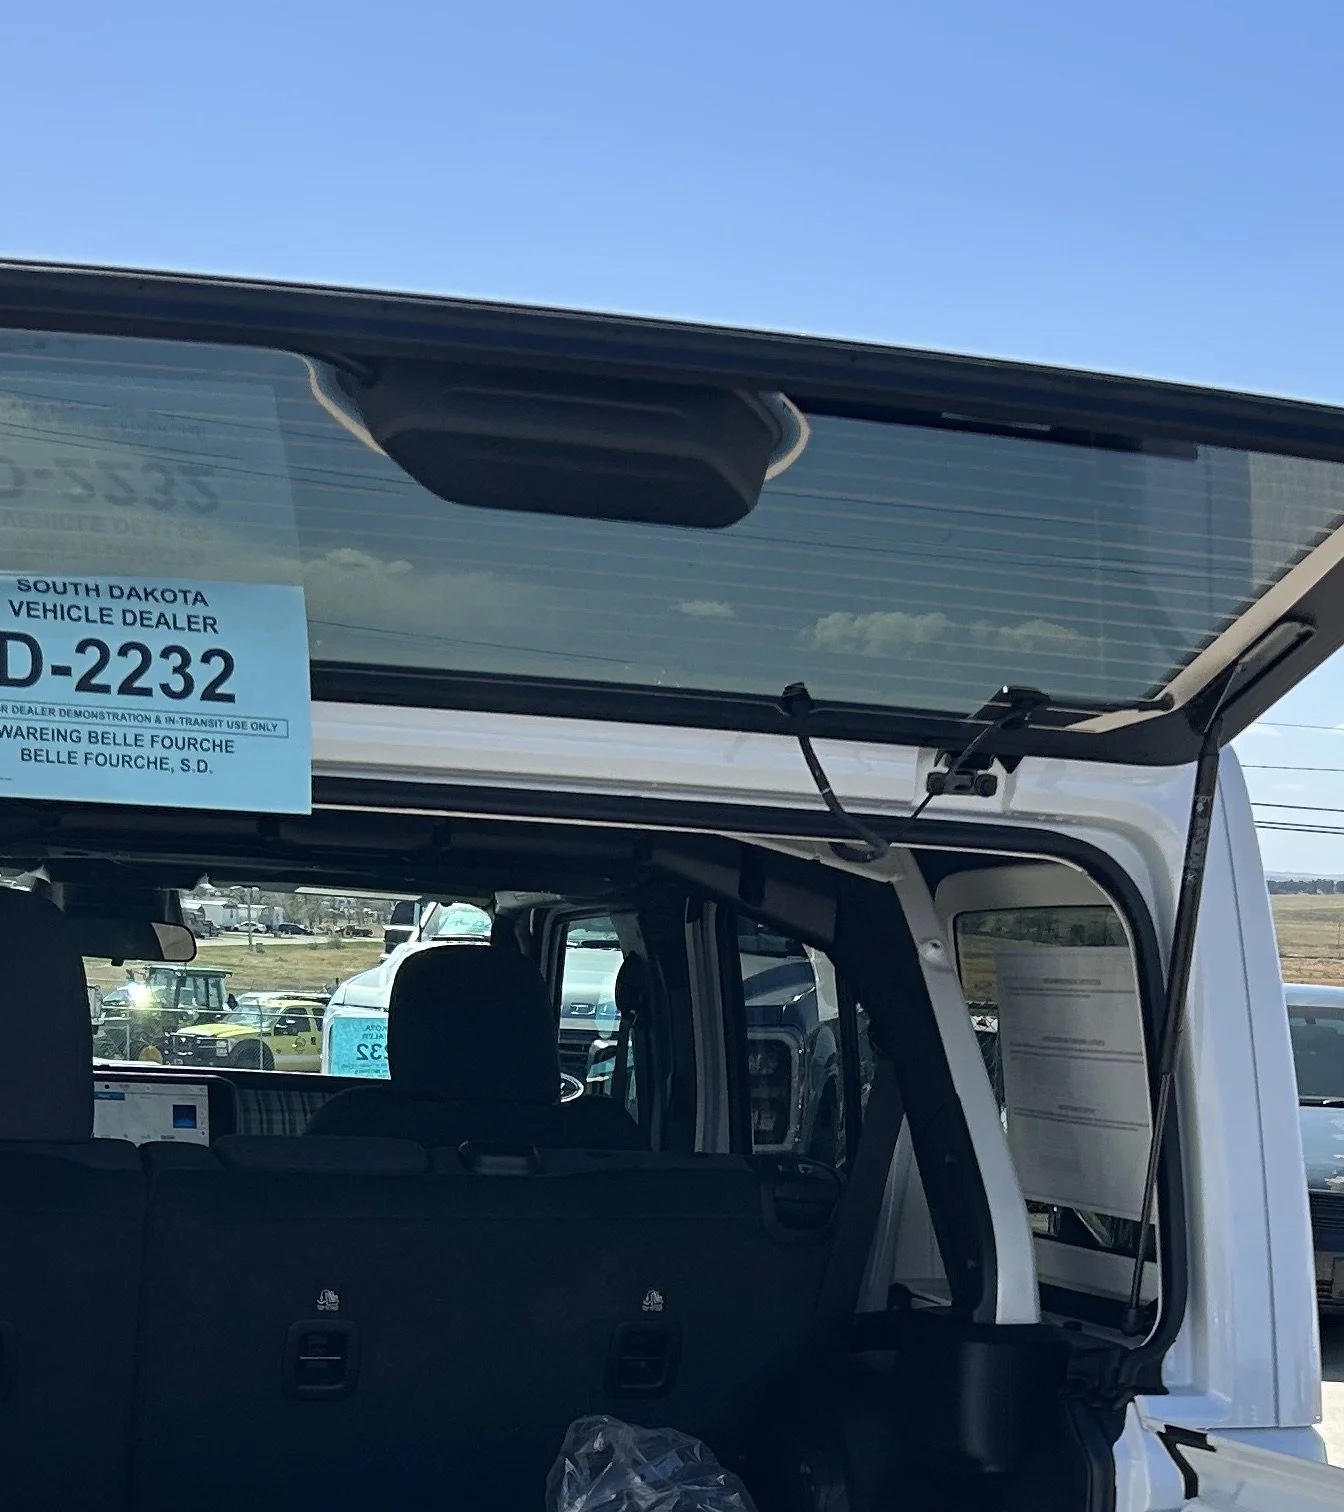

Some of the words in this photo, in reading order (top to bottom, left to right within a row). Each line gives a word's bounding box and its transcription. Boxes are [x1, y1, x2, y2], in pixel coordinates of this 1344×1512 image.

[16, 578, 100, 598] SOUTH
[109, 584, 209, 607] DAKOTA
[8, 599, 114, 625] VEHICLE
[122, 608, 219, 634] DEALER
[11, 704, 57, 717] DEALER
[58, 707, 152, 723] DEMONSTRATION
[154, 714, 162, 725] &
[164, 715, 224, 729] IN-TRANSIT
[226, 719, 248, 731] USE
[250, 721, 278, 732] ONLY
[87, 730, 145, 748] BELLE
[150, 734, 235, 754] FOURCHE
[20, 748, 78, 766] BELLE
[84, 752, 175, 774] FOURCHE,
[180, 758, 213, 775] S.D.
